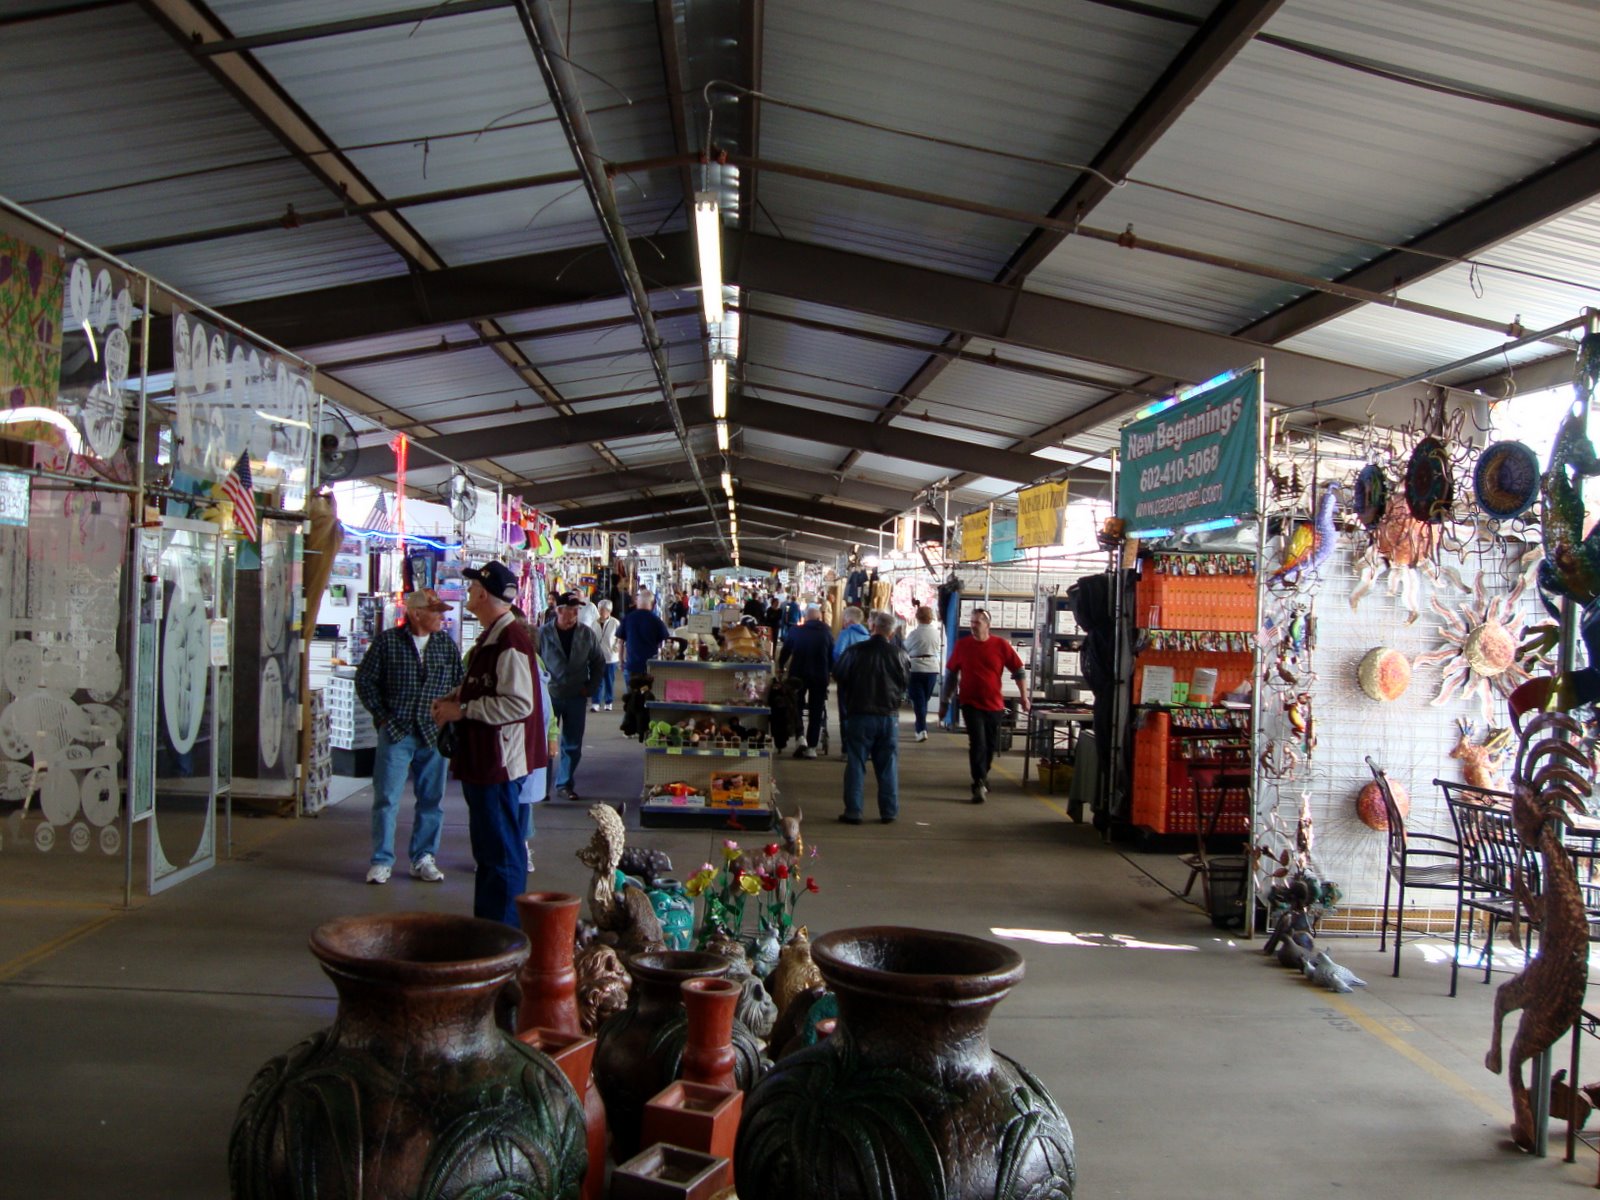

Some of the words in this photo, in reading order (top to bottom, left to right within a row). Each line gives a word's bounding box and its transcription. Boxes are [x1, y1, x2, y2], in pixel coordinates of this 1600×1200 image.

[1127, 432, 1155, 461] New
[1156, 397, 1243, 452] Beginnings
[1140, 445, 1220, 493] 602-410-5068
[570, 532, 628, 547] KNS
